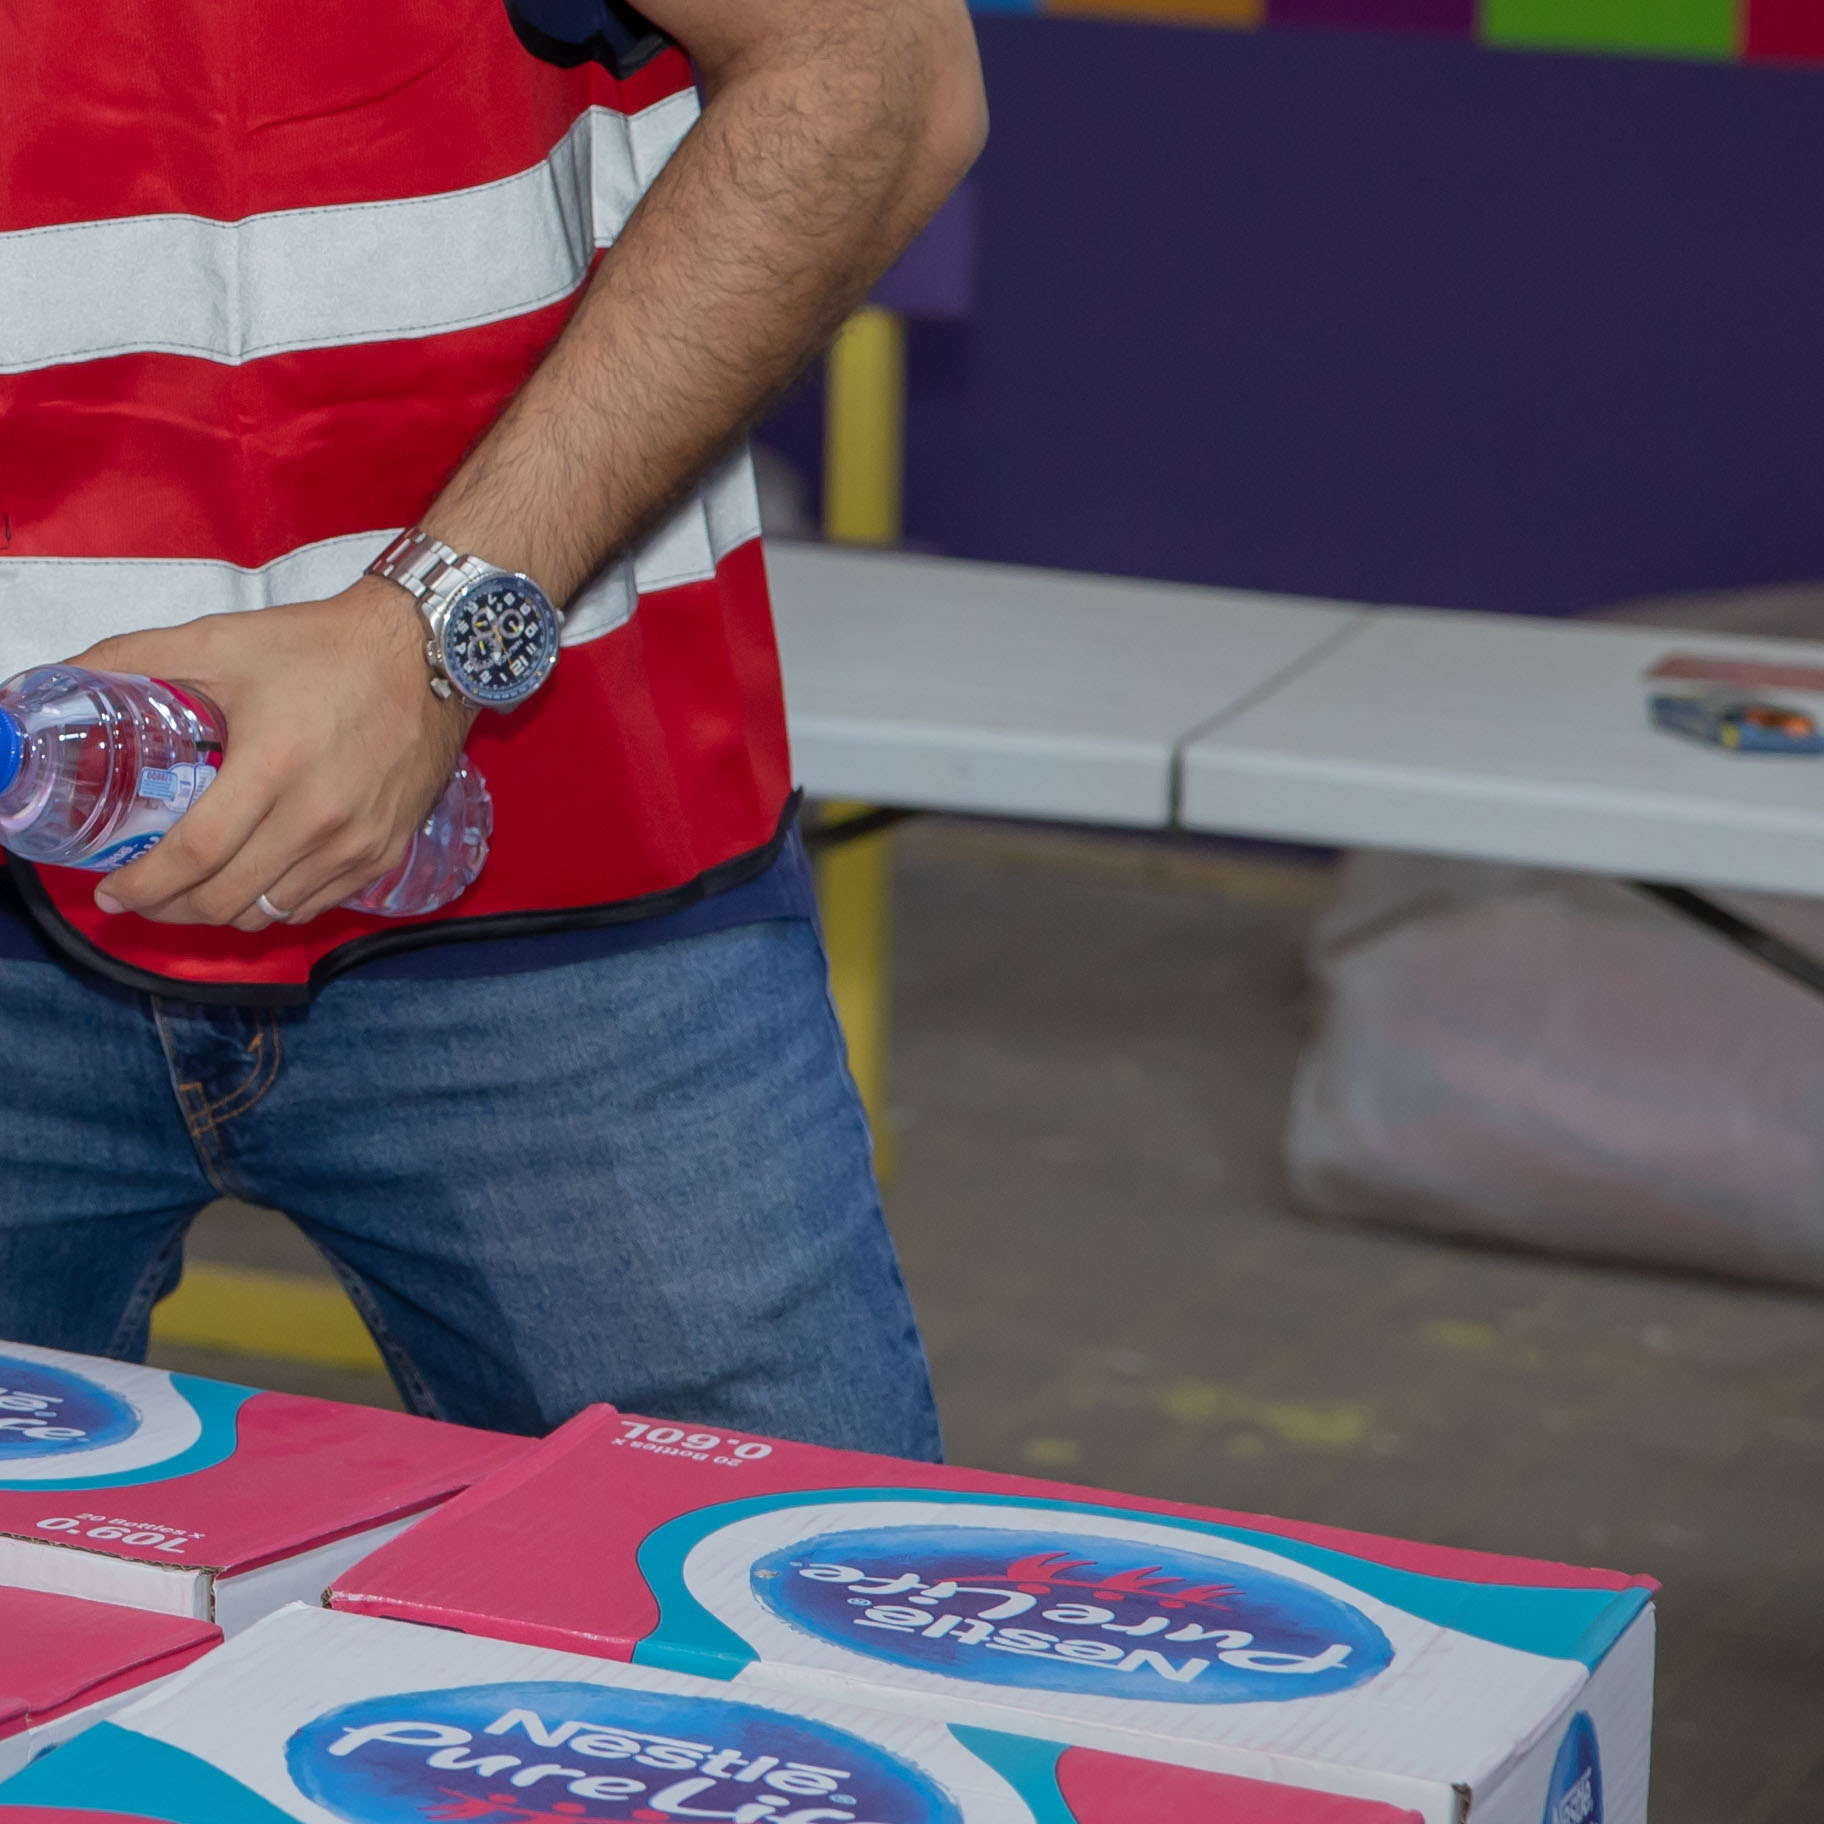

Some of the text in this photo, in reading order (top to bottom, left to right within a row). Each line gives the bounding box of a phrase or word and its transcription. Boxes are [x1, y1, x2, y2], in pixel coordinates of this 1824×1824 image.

[621, 1420, 773, 1460] 0.60L
[630, 1441, 709, 1461] Bottles
[36, 1517, 189, 1554] 0.60L
[75, 1512, 107, 1522] 20
[108, 1518, 187, 1536] Bottles
[853, 1602, 1210, 1683] Nestlé
[483, 1708, 851, 1797] Nestlé
